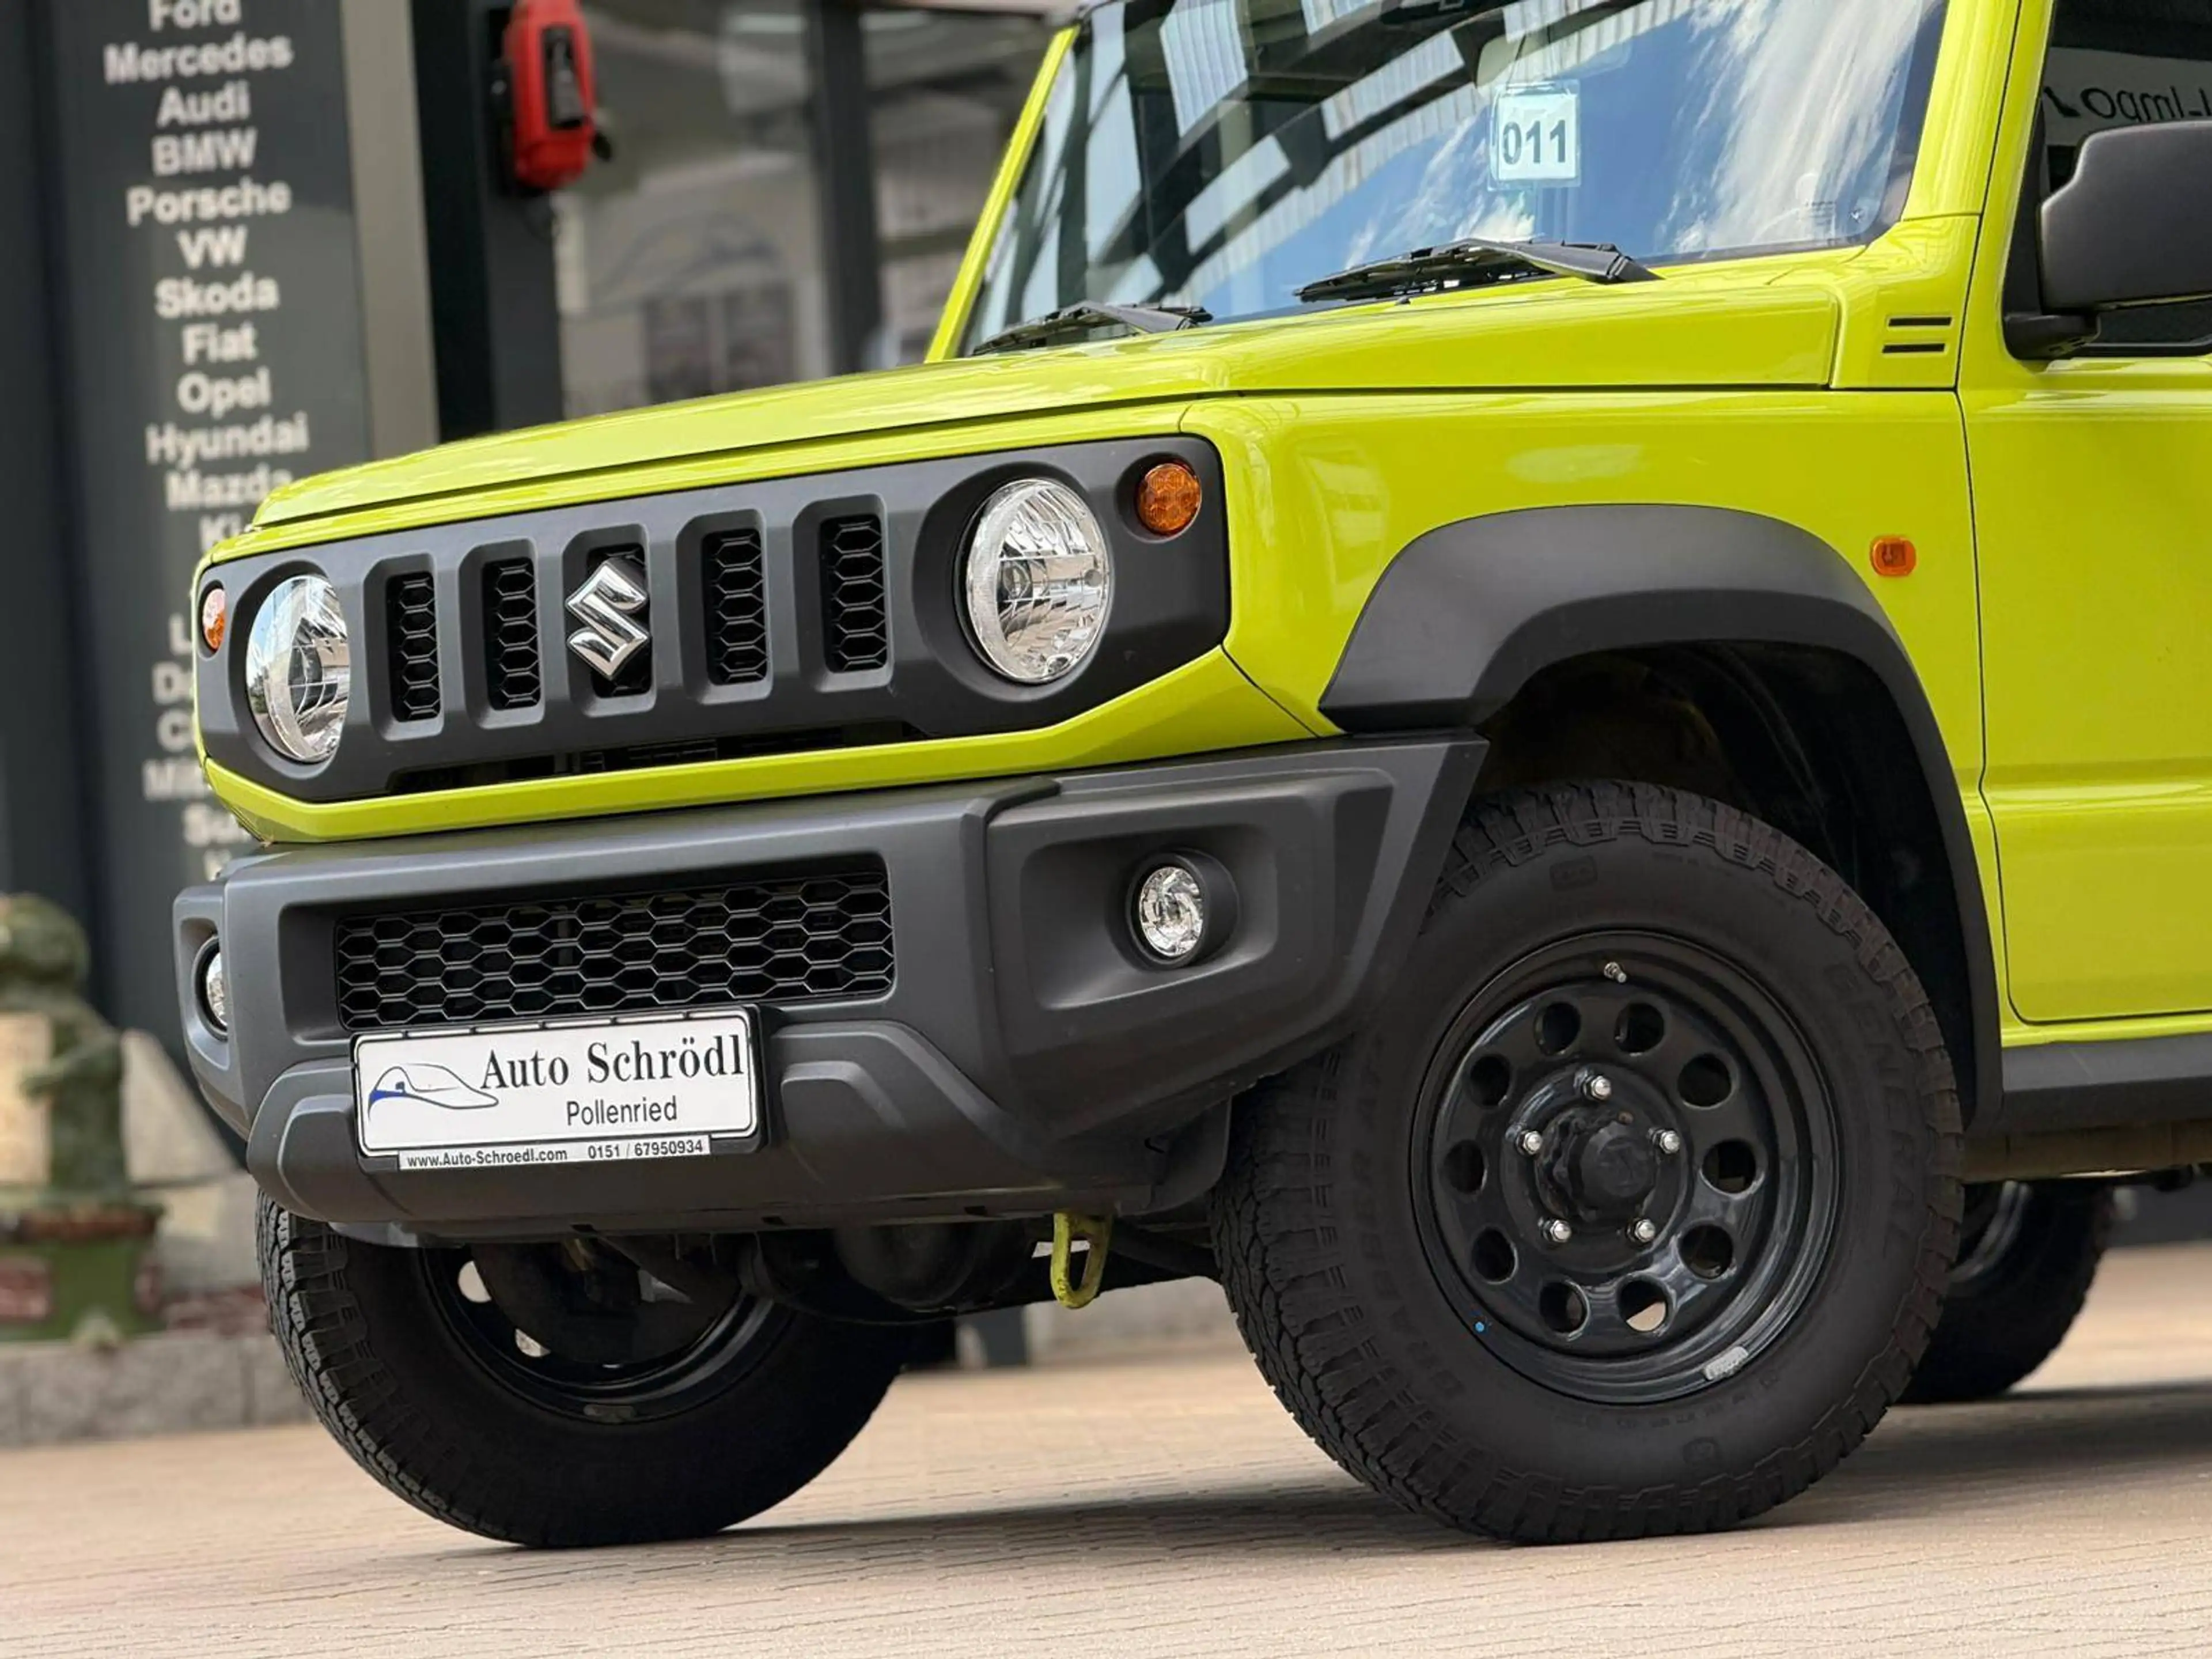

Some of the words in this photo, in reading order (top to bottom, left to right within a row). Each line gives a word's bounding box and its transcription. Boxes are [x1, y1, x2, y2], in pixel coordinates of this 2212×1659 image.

[149, 0, 242, 31] Ford
[104, 31, 294, 84] Mercedes
[156, 79, 251, 128] Audi
[151, 126, 258, 176] BMW
[1502, 119, 1567, 165] 011
[126, 176, 291, 227] Porsche
[176, 224, 247, 269] VW
[155, 270, 280, 319] Skoda
[182, 320, 258, 365] Fiat
[177, 365, 272, 419] Opel
[146, 410, 310, 471] Hyundai
[199, 513, 254, 552] Ki
[480, 1048, 569, 1089] Auto
[587, 1035, 745, 1084] Schrödl
[567, 1096, 678, 1126] Pollenried
[407, 1147, 568, 1168] www.Auto-Schroedl.com
[588, 1145, 620, 1160] 0151
[634, 1140, 703, 1158] 67950934
